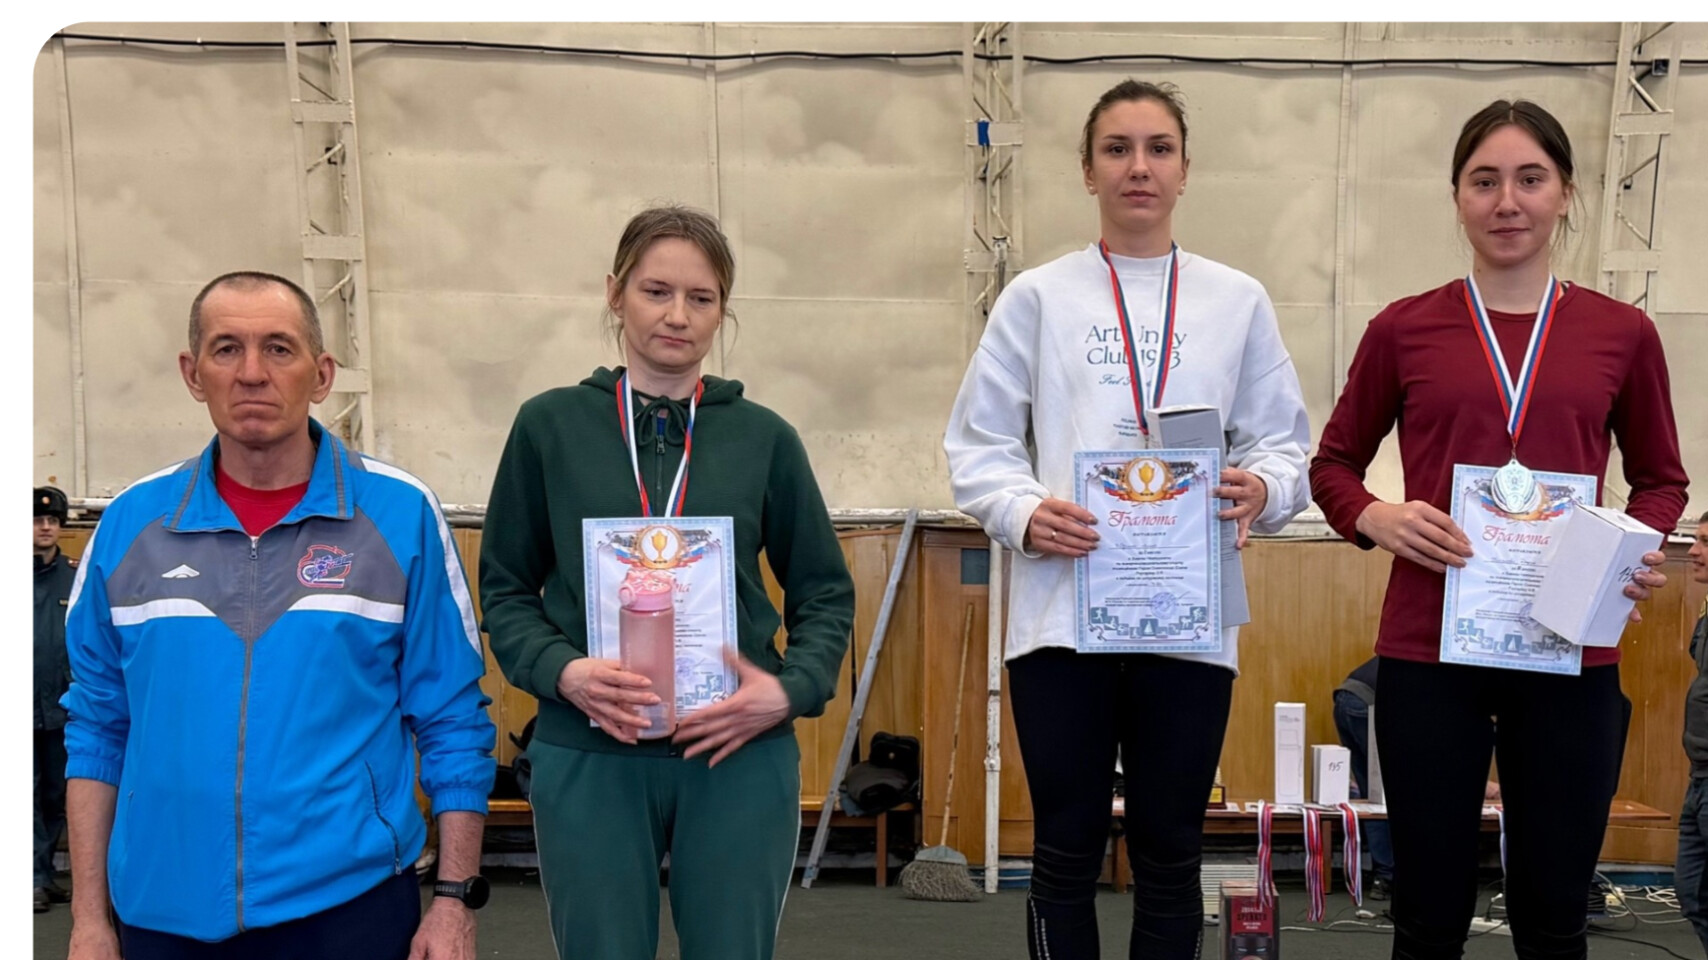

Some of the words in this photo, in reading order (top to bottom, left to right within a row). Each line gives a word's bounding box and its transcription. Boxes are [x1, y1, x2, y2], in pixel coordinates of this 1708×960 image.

[1085, 325, 1121, 344] Art
[1138, 325, 1187, 349] Uny
[1141, 349, 1181, 370] 193
[1108, 510, 1178, 531] Грамота
[1482, 525, 1551, 546] Грамота
